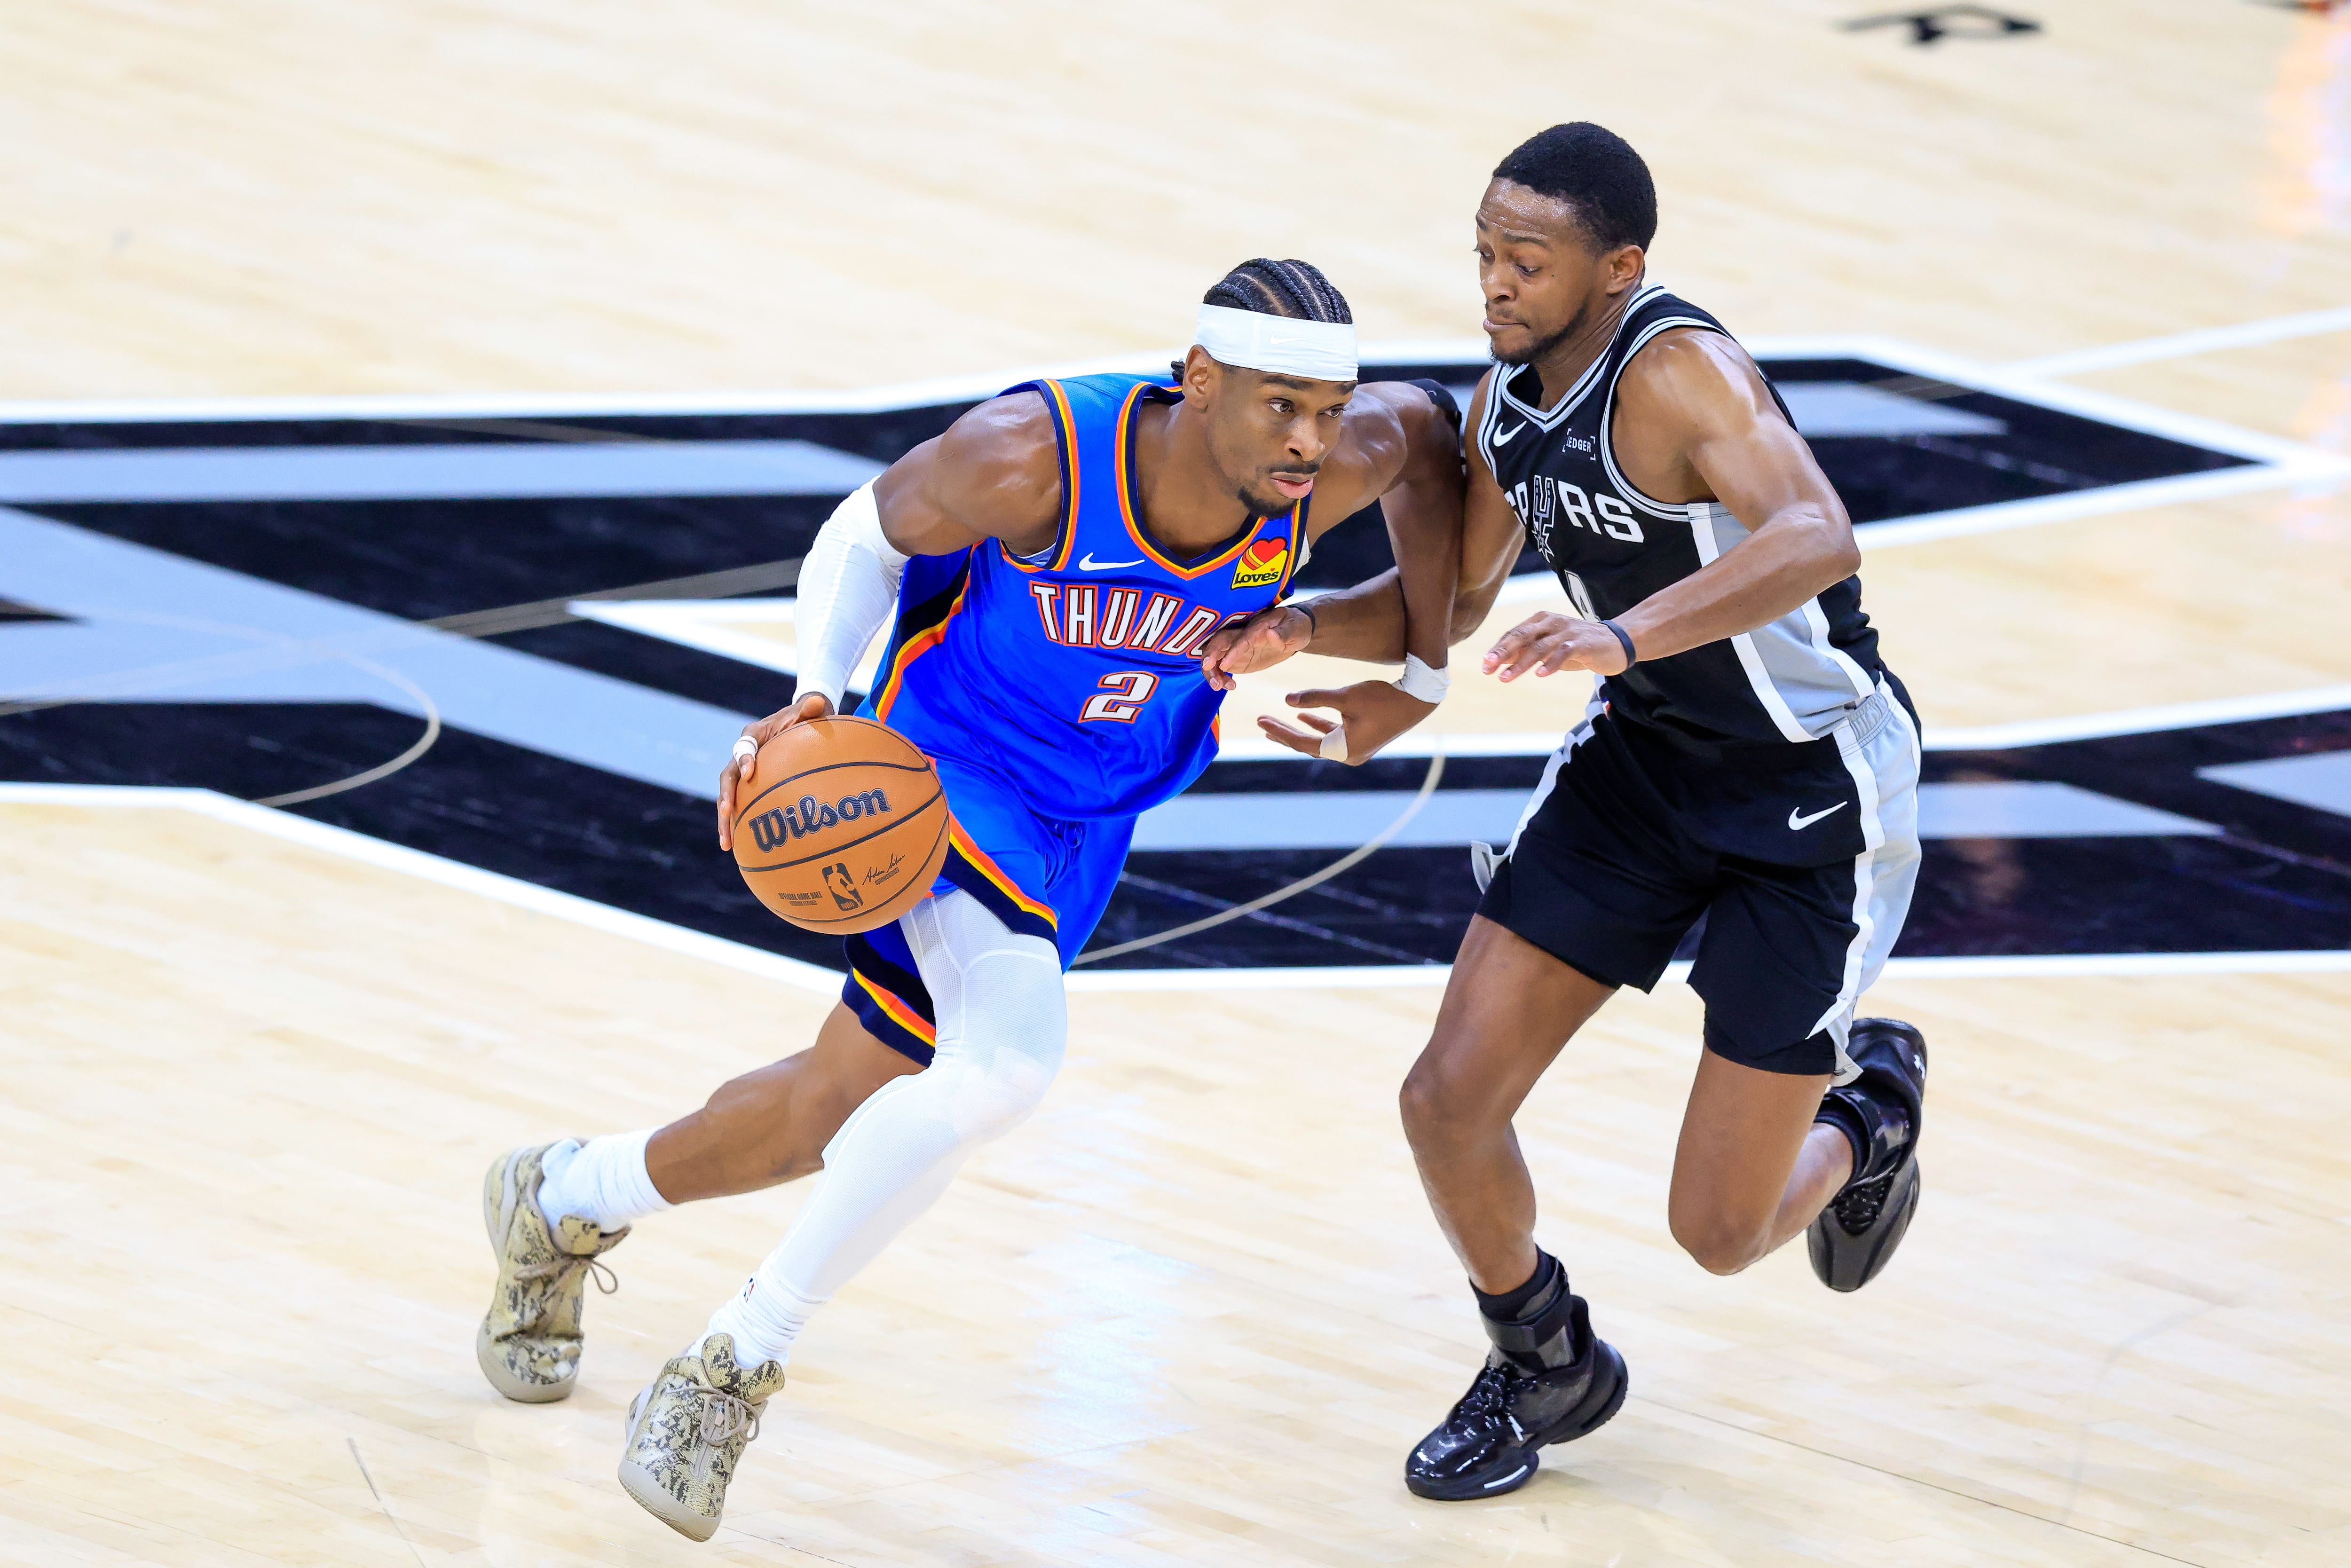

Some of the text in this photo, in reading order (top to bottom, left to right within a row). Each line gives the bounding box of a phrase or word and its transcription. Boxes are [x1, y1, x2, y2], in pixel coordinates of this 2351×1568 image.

[1029, 580, 1267, 659] THUND
[1077, 670, 1160, 724] 2
[748, 788, 892, 853] Wilson
